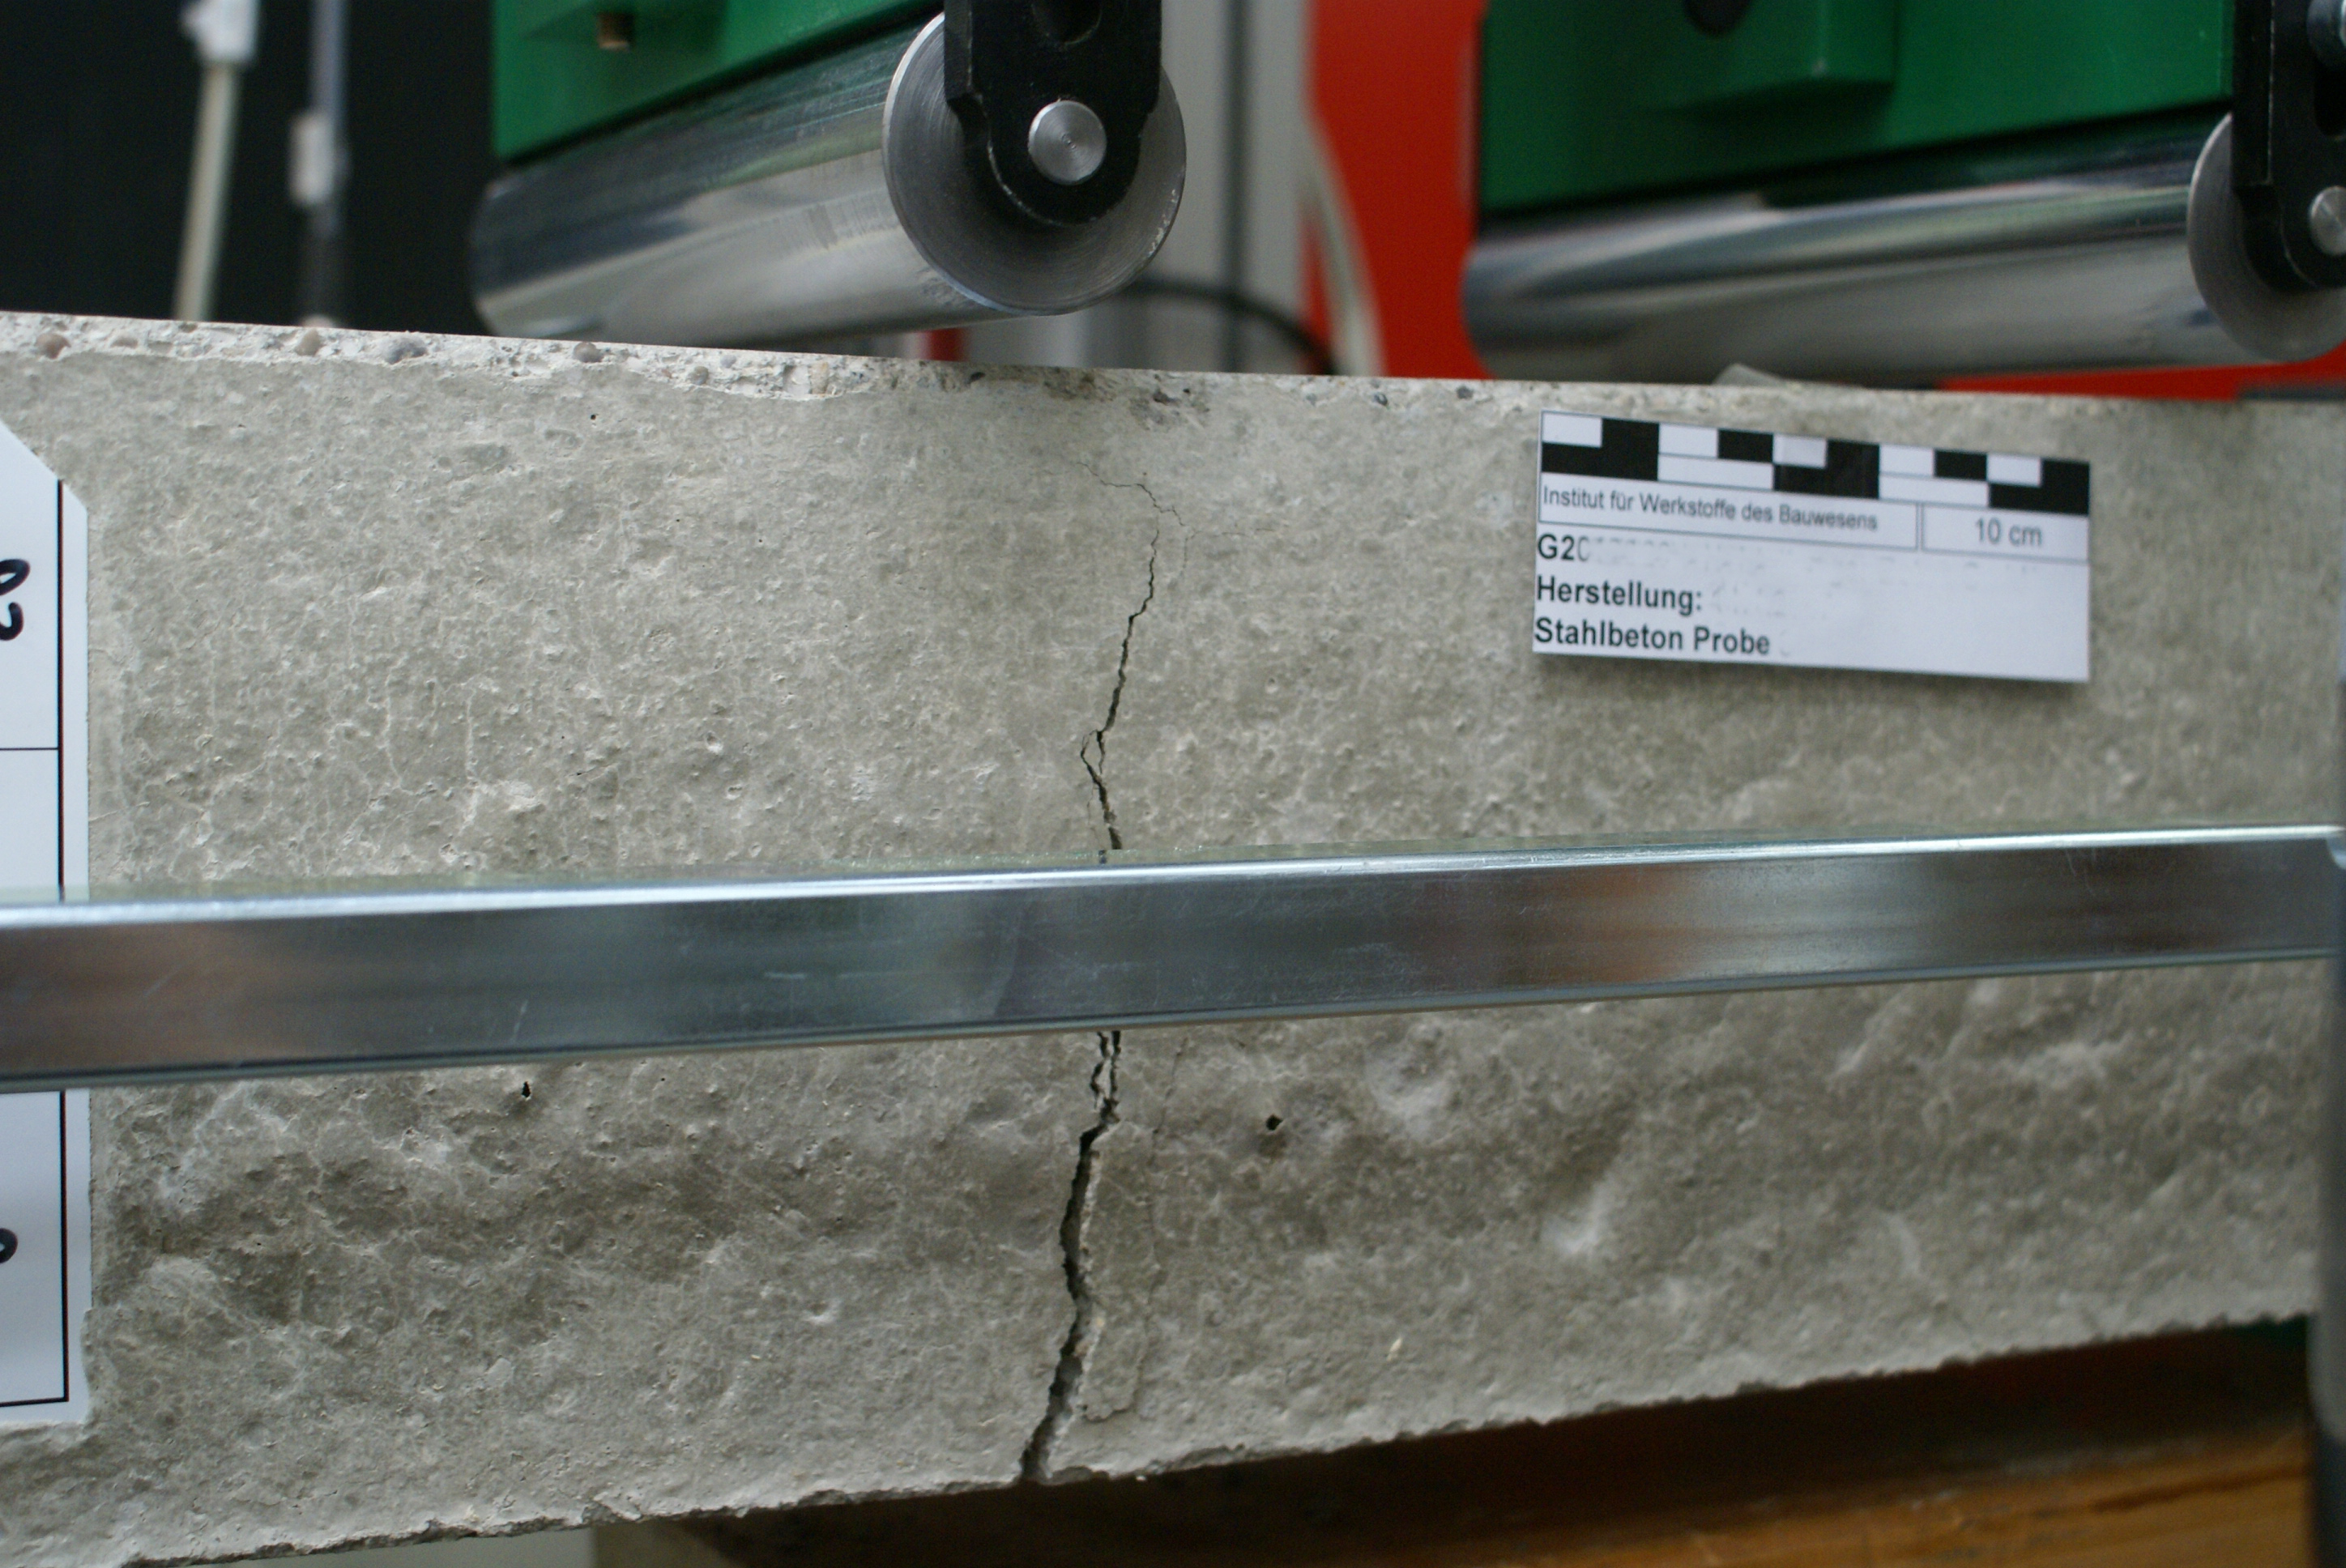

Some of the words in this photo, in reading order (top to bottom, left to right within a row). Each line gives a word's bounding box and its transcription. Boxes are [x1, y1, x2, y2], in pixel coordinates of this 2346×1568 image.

[1543, 486, 1604, 509] Institut
[1610, 490, 1634, 511] für
[1639, 492, 1737, 519] Werkstoffe
[1742, 503, 1773, 523] des
[1779, 504, 1879, 530] Bauwesens
[1976, 518, 2001, 543] 10
[2008, 524, 2043, 545] cm
[1537, 575, 1702, 616] Herstellung:
[1534, 616, 1683, 650] Stahlbeton
[1693, 626, 1771, 654] Probe
